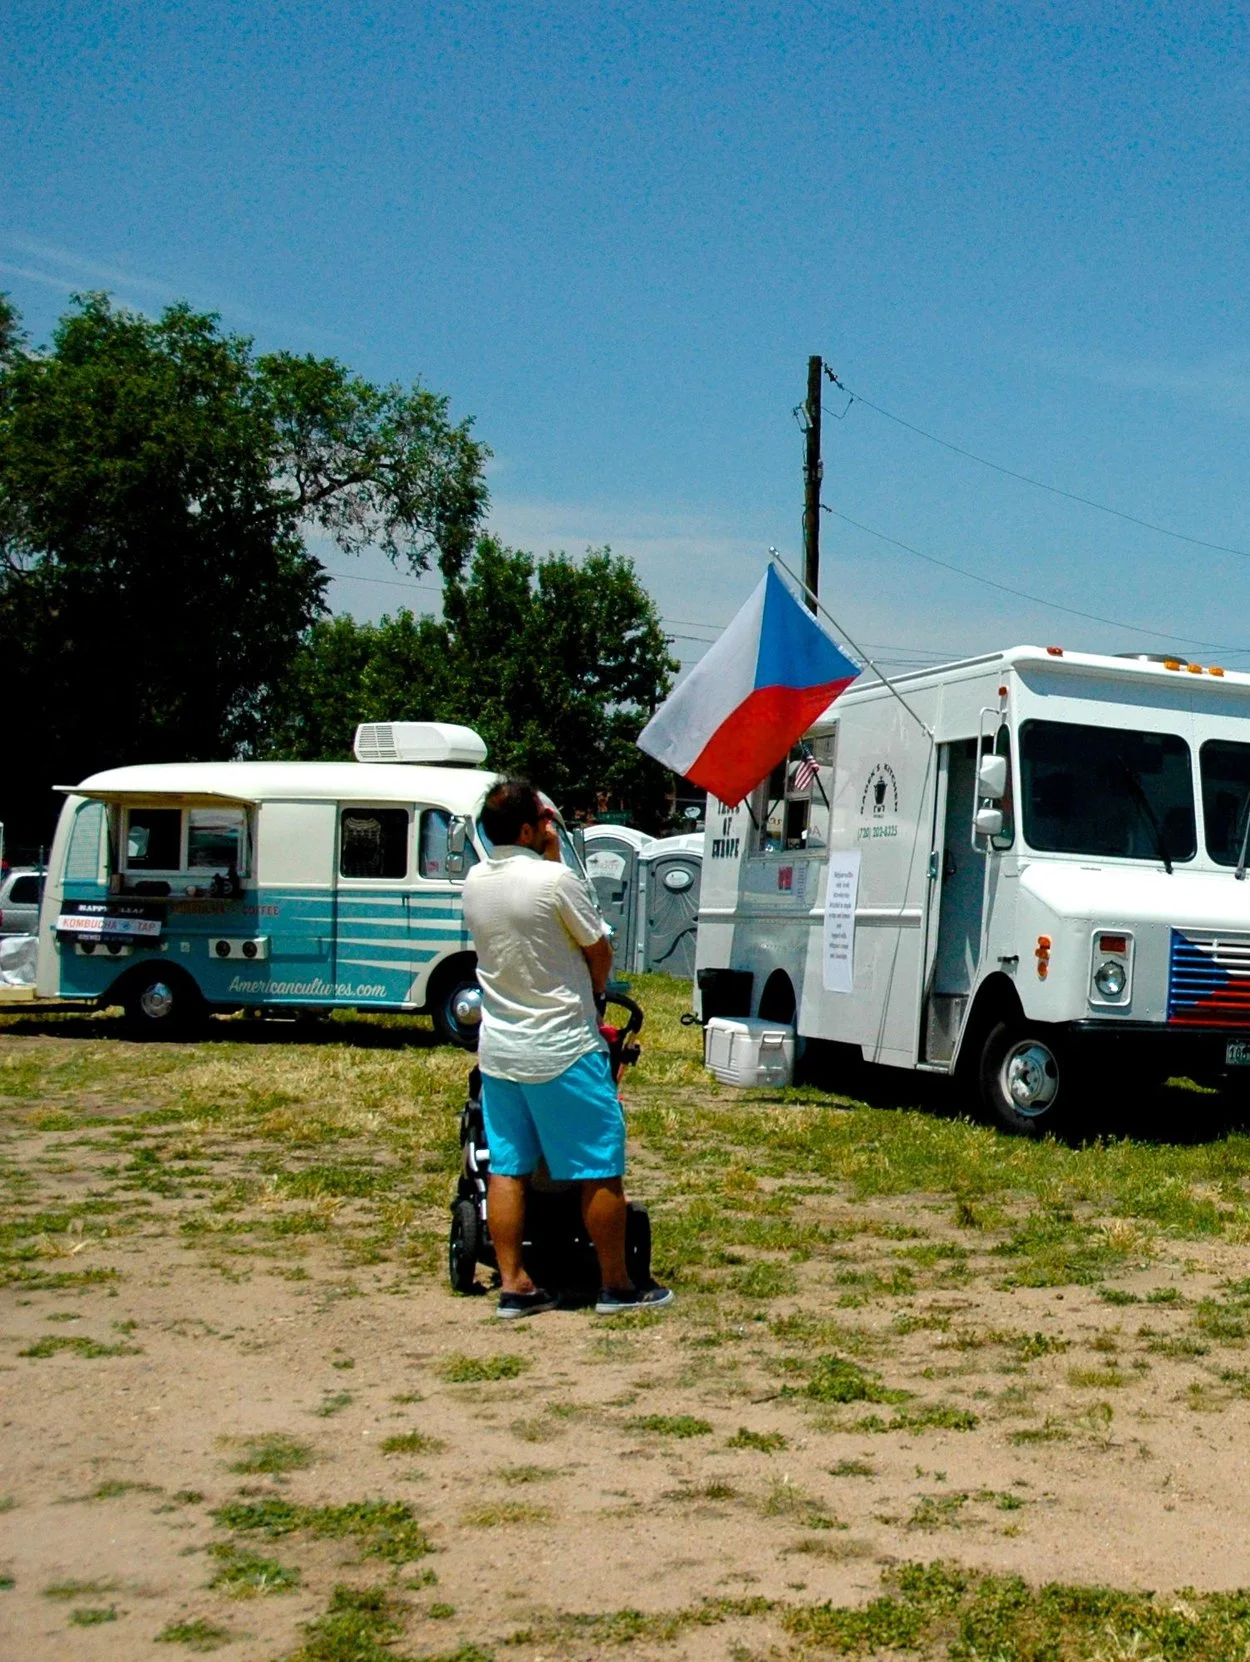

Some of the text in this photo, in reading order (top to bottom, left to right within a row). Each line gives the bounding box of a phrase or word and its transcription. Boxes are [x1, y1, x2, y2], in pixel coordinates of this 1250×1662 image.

[722, 817, 733, 836] OF
[62, 918, 157, 933] KOMBUCHA TAP
